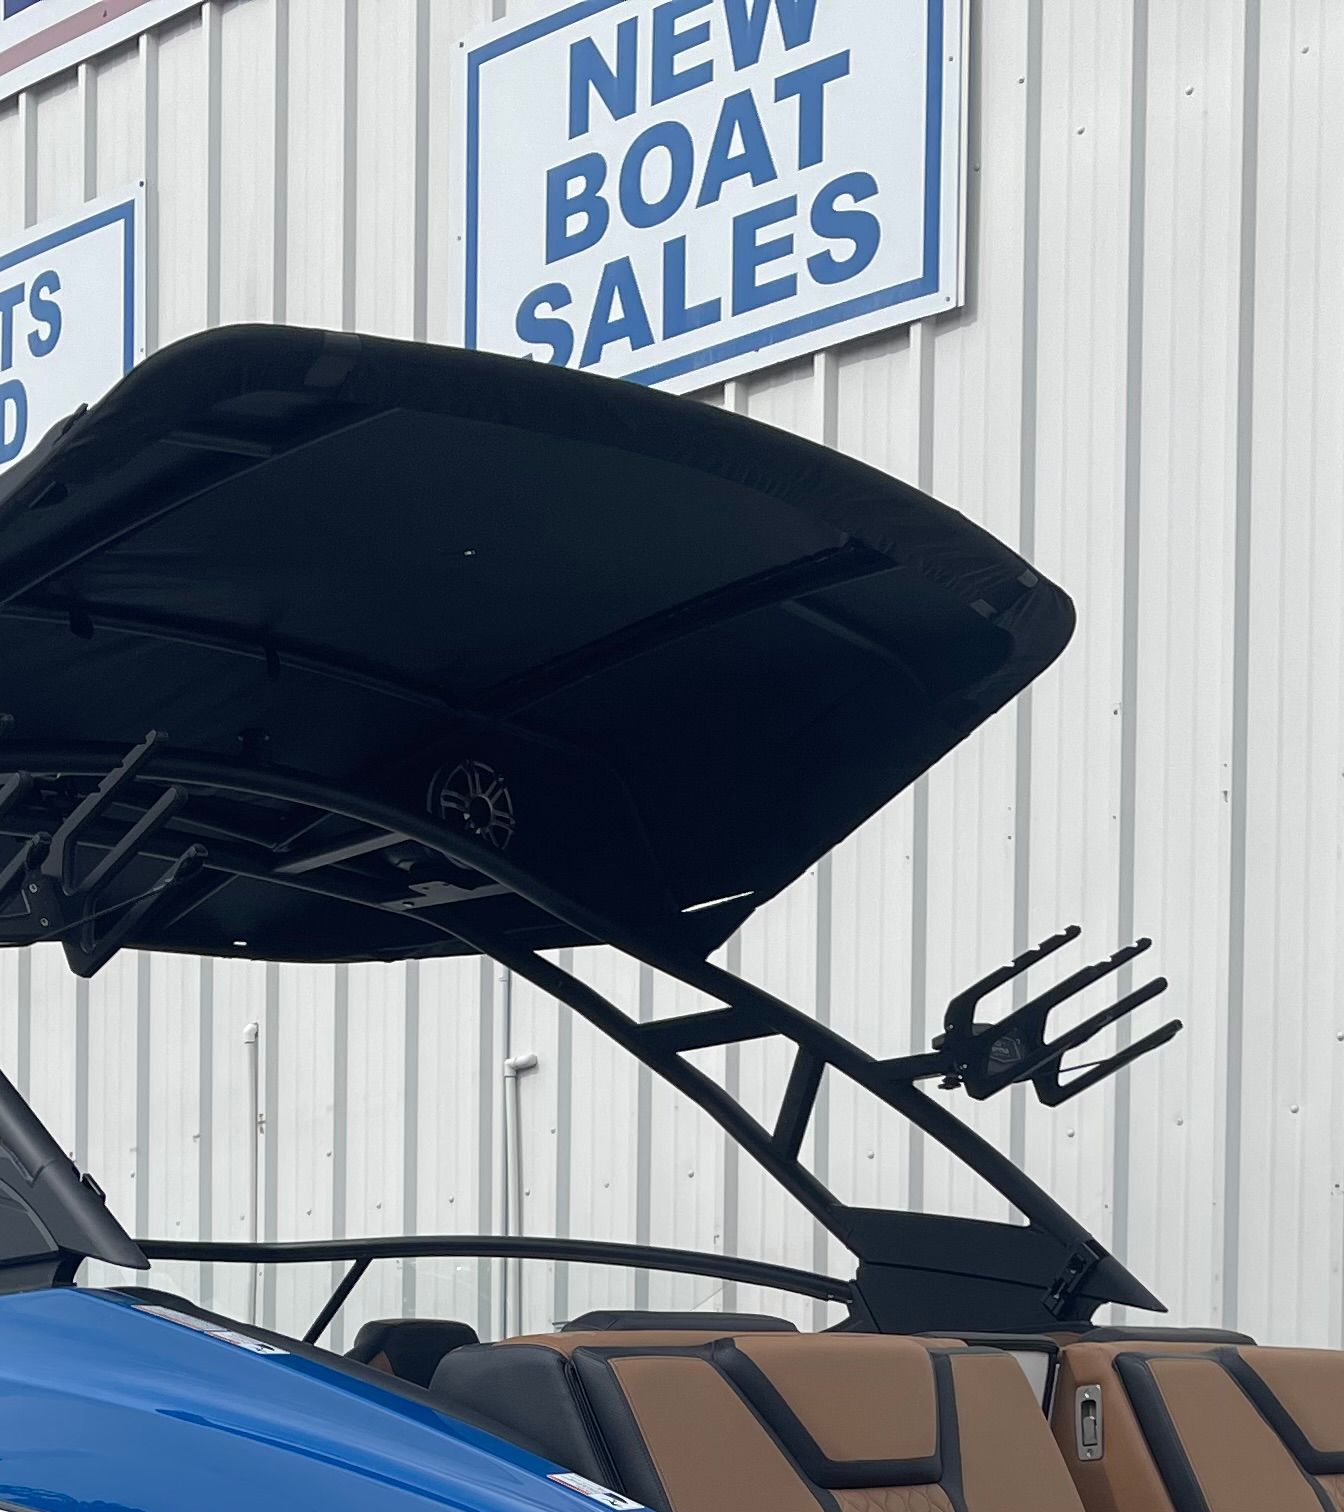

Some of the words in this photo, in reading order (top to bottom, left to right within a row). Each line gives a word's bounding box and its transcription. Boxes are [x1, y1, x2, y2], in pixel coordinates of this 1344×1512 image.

[545, 49, 851, 265] BOAT
[568, 0, 817, 140] NEW
[514, 171, 881, 369] SALES
